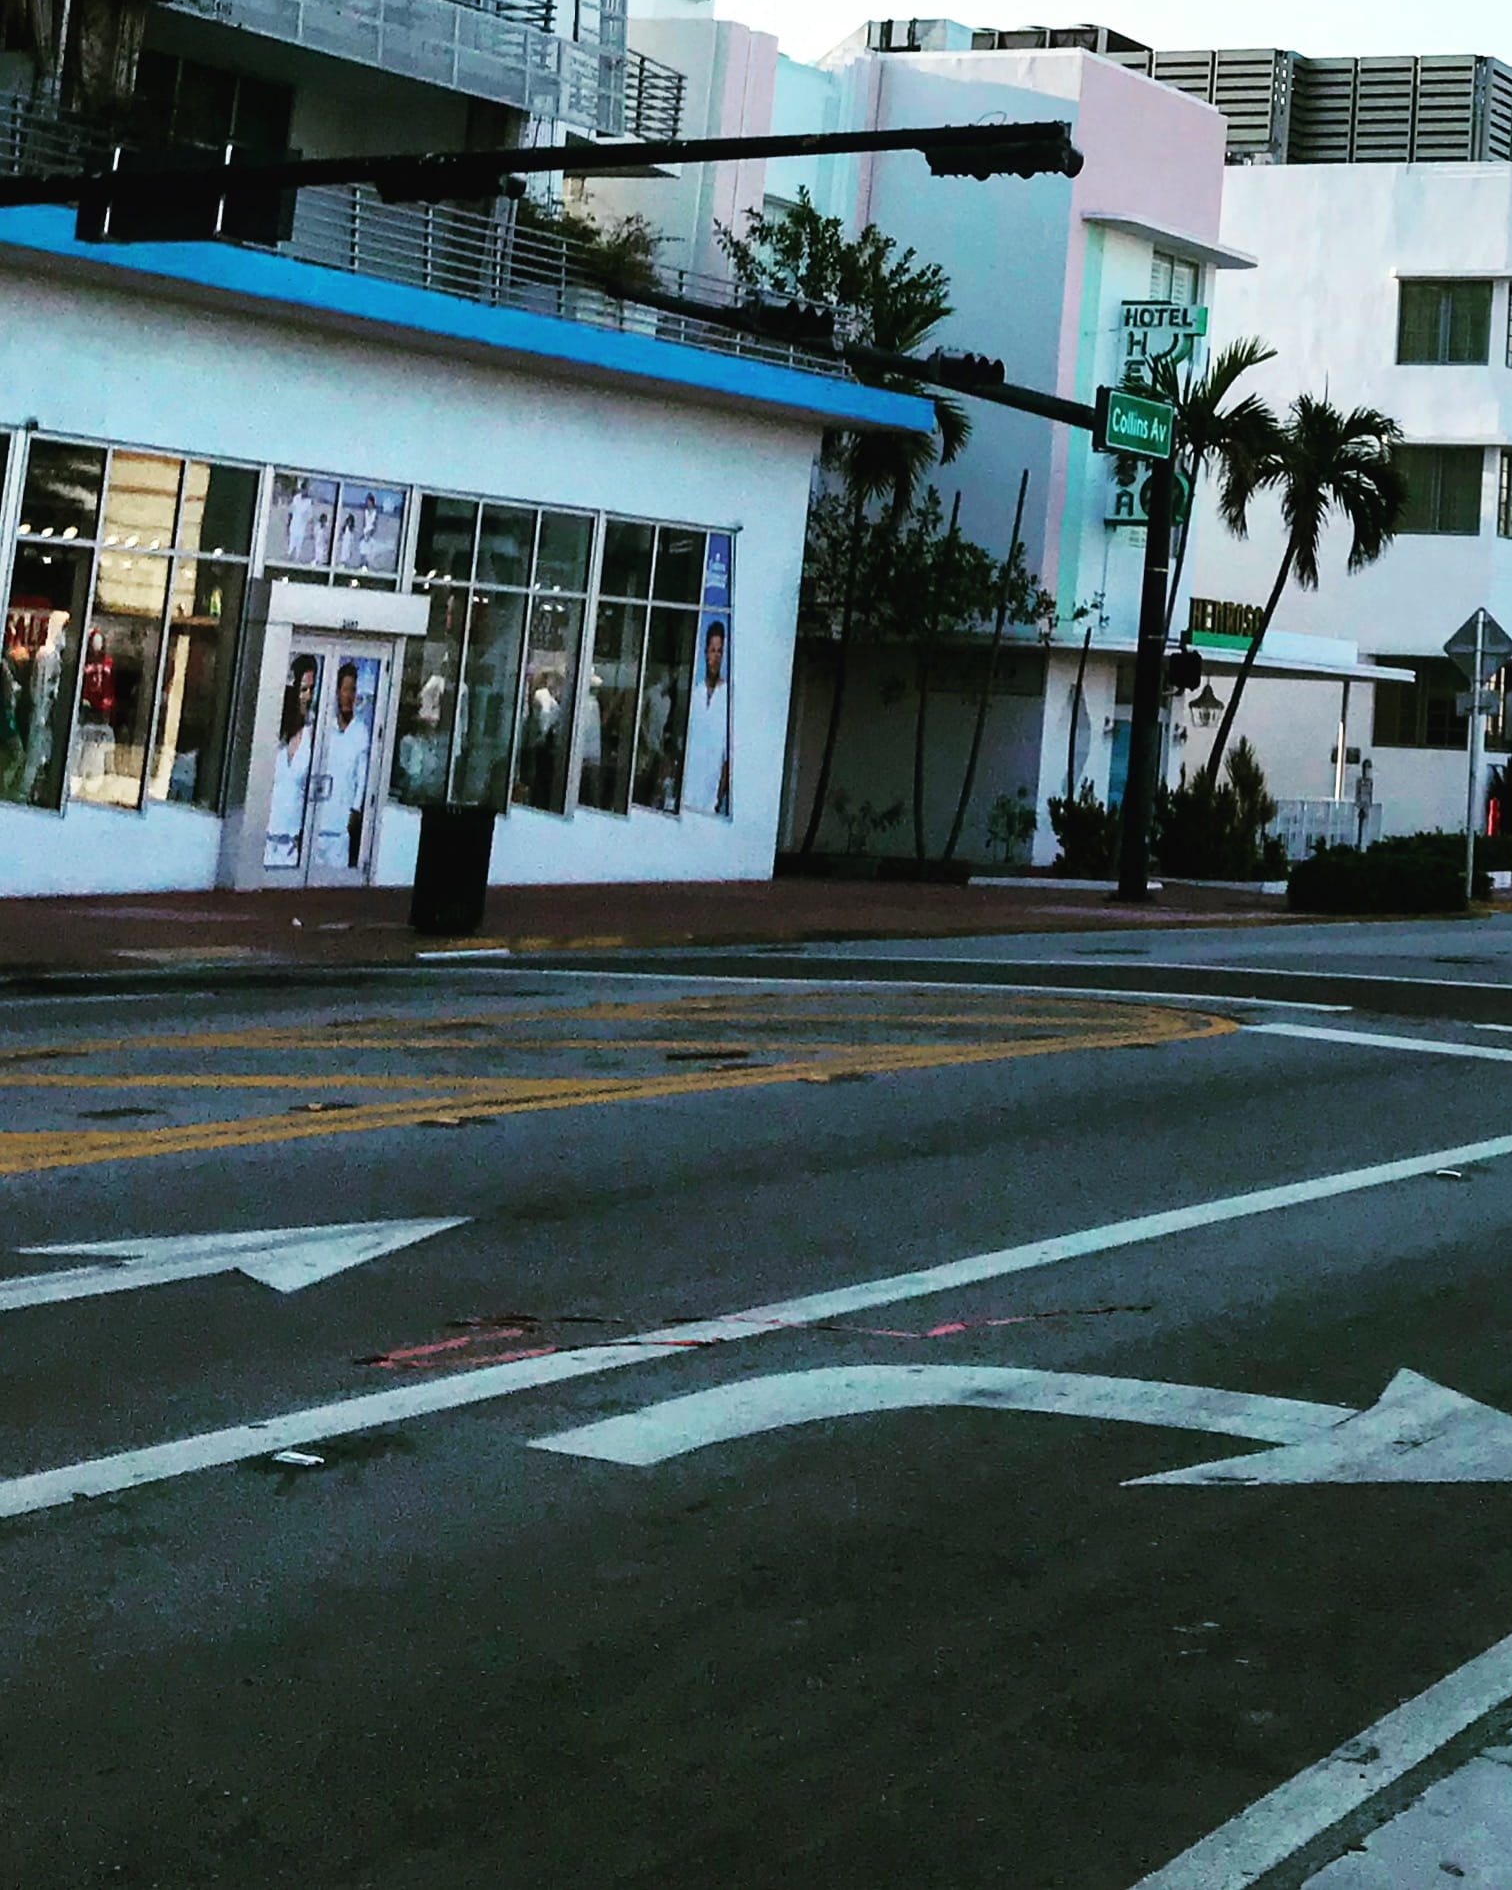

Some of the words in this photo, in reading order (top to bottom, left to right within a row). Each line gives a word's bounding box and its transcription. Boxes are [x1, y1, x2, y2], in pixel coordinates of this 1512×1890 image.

[1124, 307, 1193, 327] HOTEL
[1112, 407, 1149, 439] Collins
[1150, 416, 1167, 443] Av
